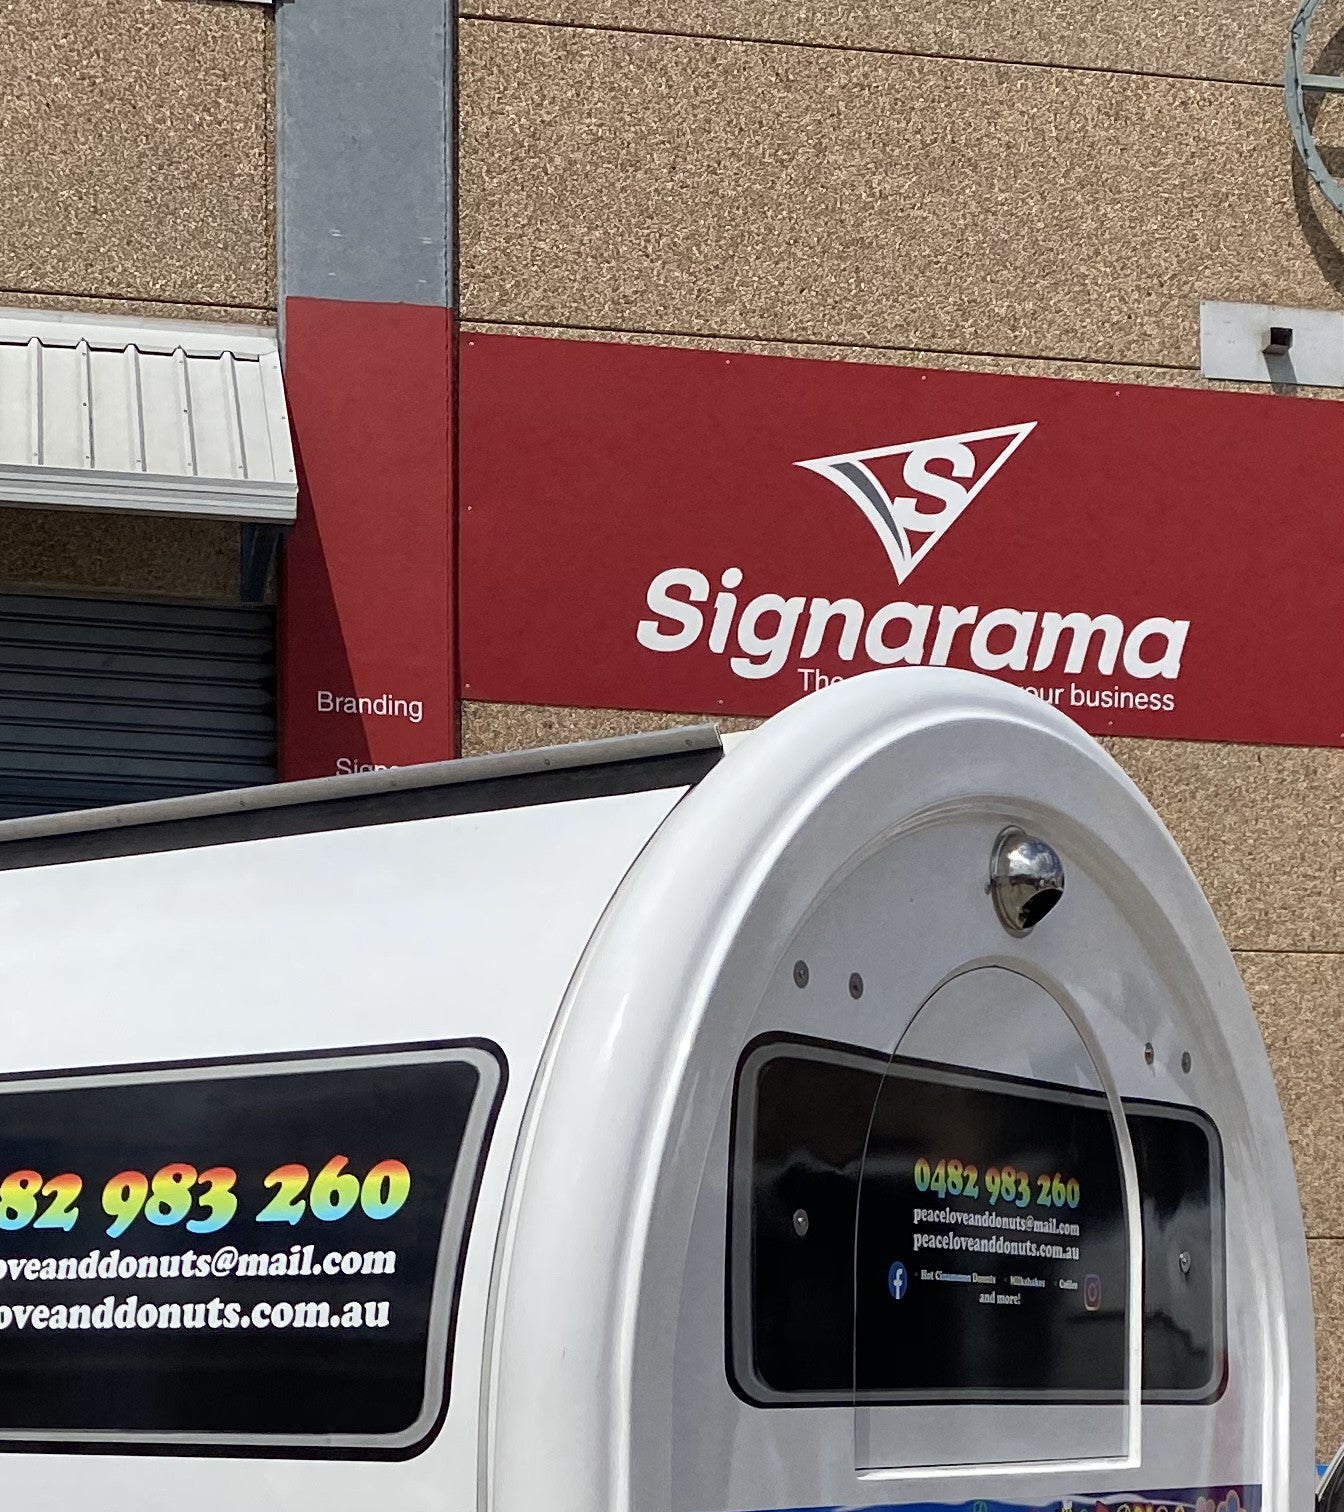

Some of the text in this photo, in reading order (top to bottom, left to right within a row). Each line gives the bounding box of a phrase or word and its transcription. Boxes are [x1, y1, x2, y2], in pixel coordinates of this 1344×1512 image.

[635, 565, 1191, 680] Signarama
[317, 690, 423, 723] Branding
[1070, 683, 1175, 711] business
[101, 1162, 238, 1239] 983
[256, 1154, 411, 1227] 260
[914, 1157, 1081, 1209] 0482 983 260
[913, 1206, 1080, 1237] peaceloveanddonuts@mail.com
[913, 1231, 1080, 1261] peaceloveanddonuts.com.au
[979, 1291, 996, 1304] and
